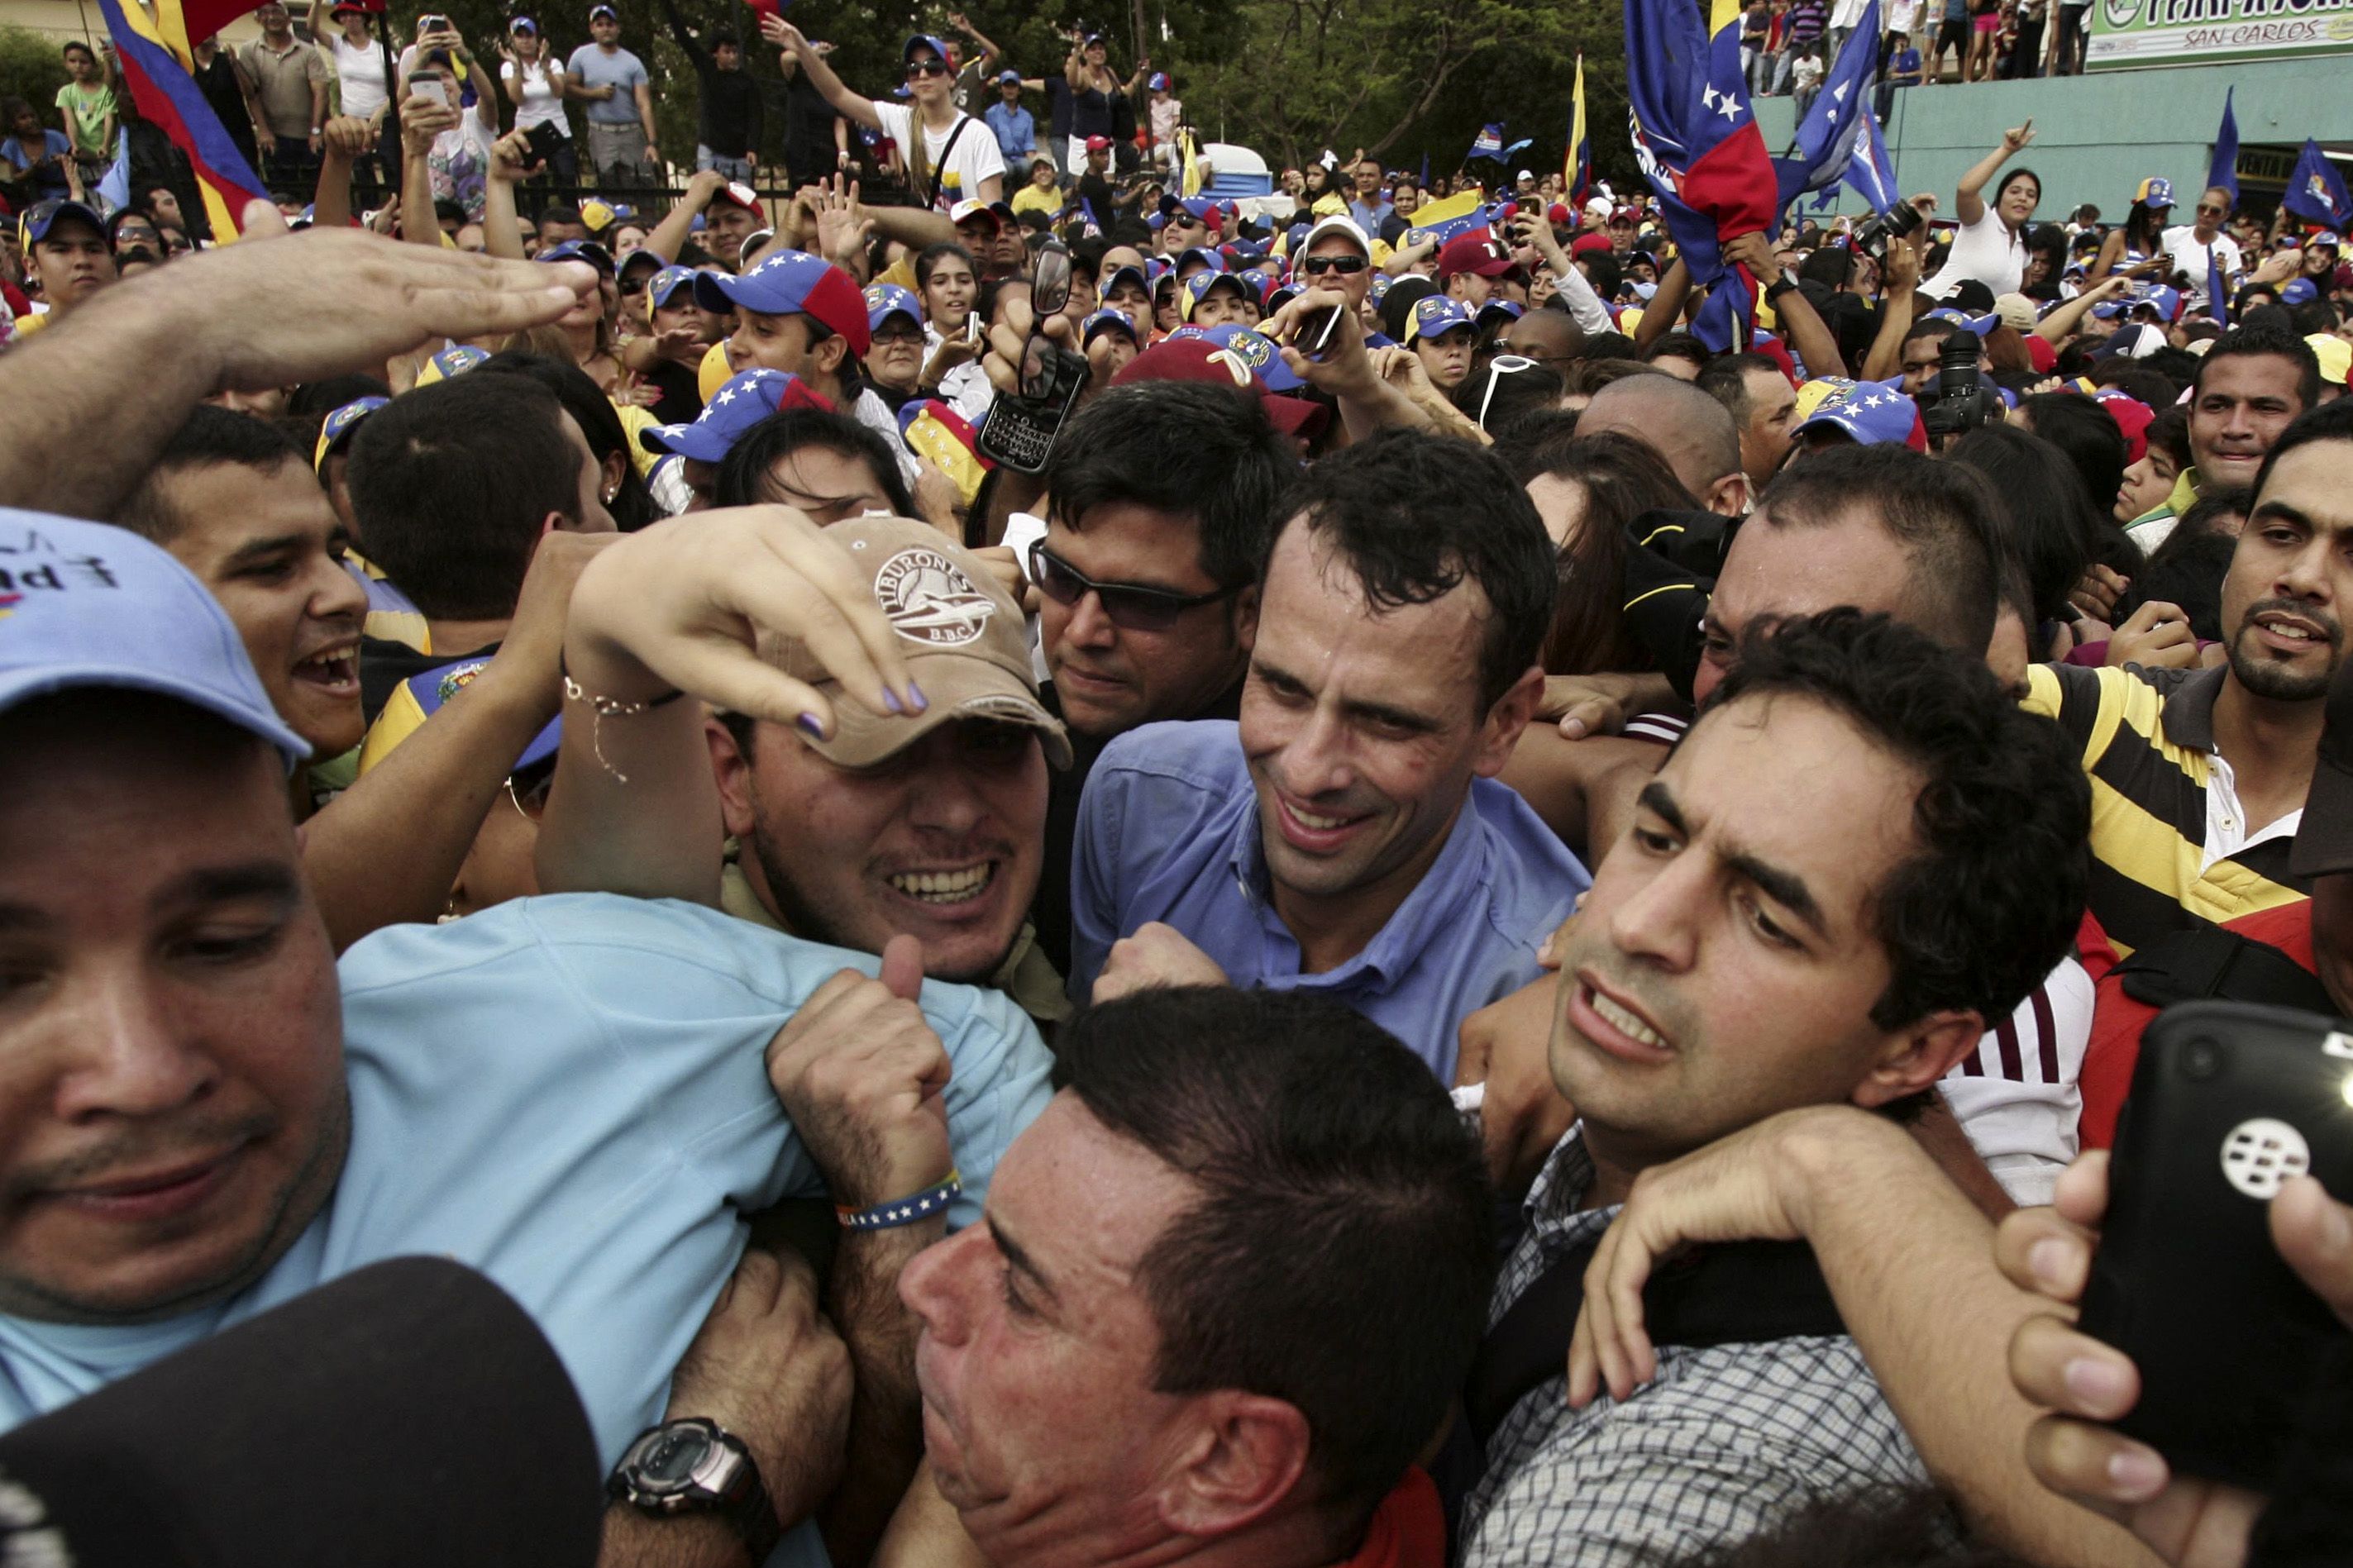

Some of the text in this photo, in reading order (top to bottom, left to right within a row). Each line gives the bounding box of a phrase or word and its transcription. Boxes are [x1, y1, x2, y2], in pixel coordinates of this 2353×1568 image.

[2184, 27, 2226, 47] SAN
[2232, 19, 2319, 43] CARLOS
[878, 553, 971, 611] TIBURONES
